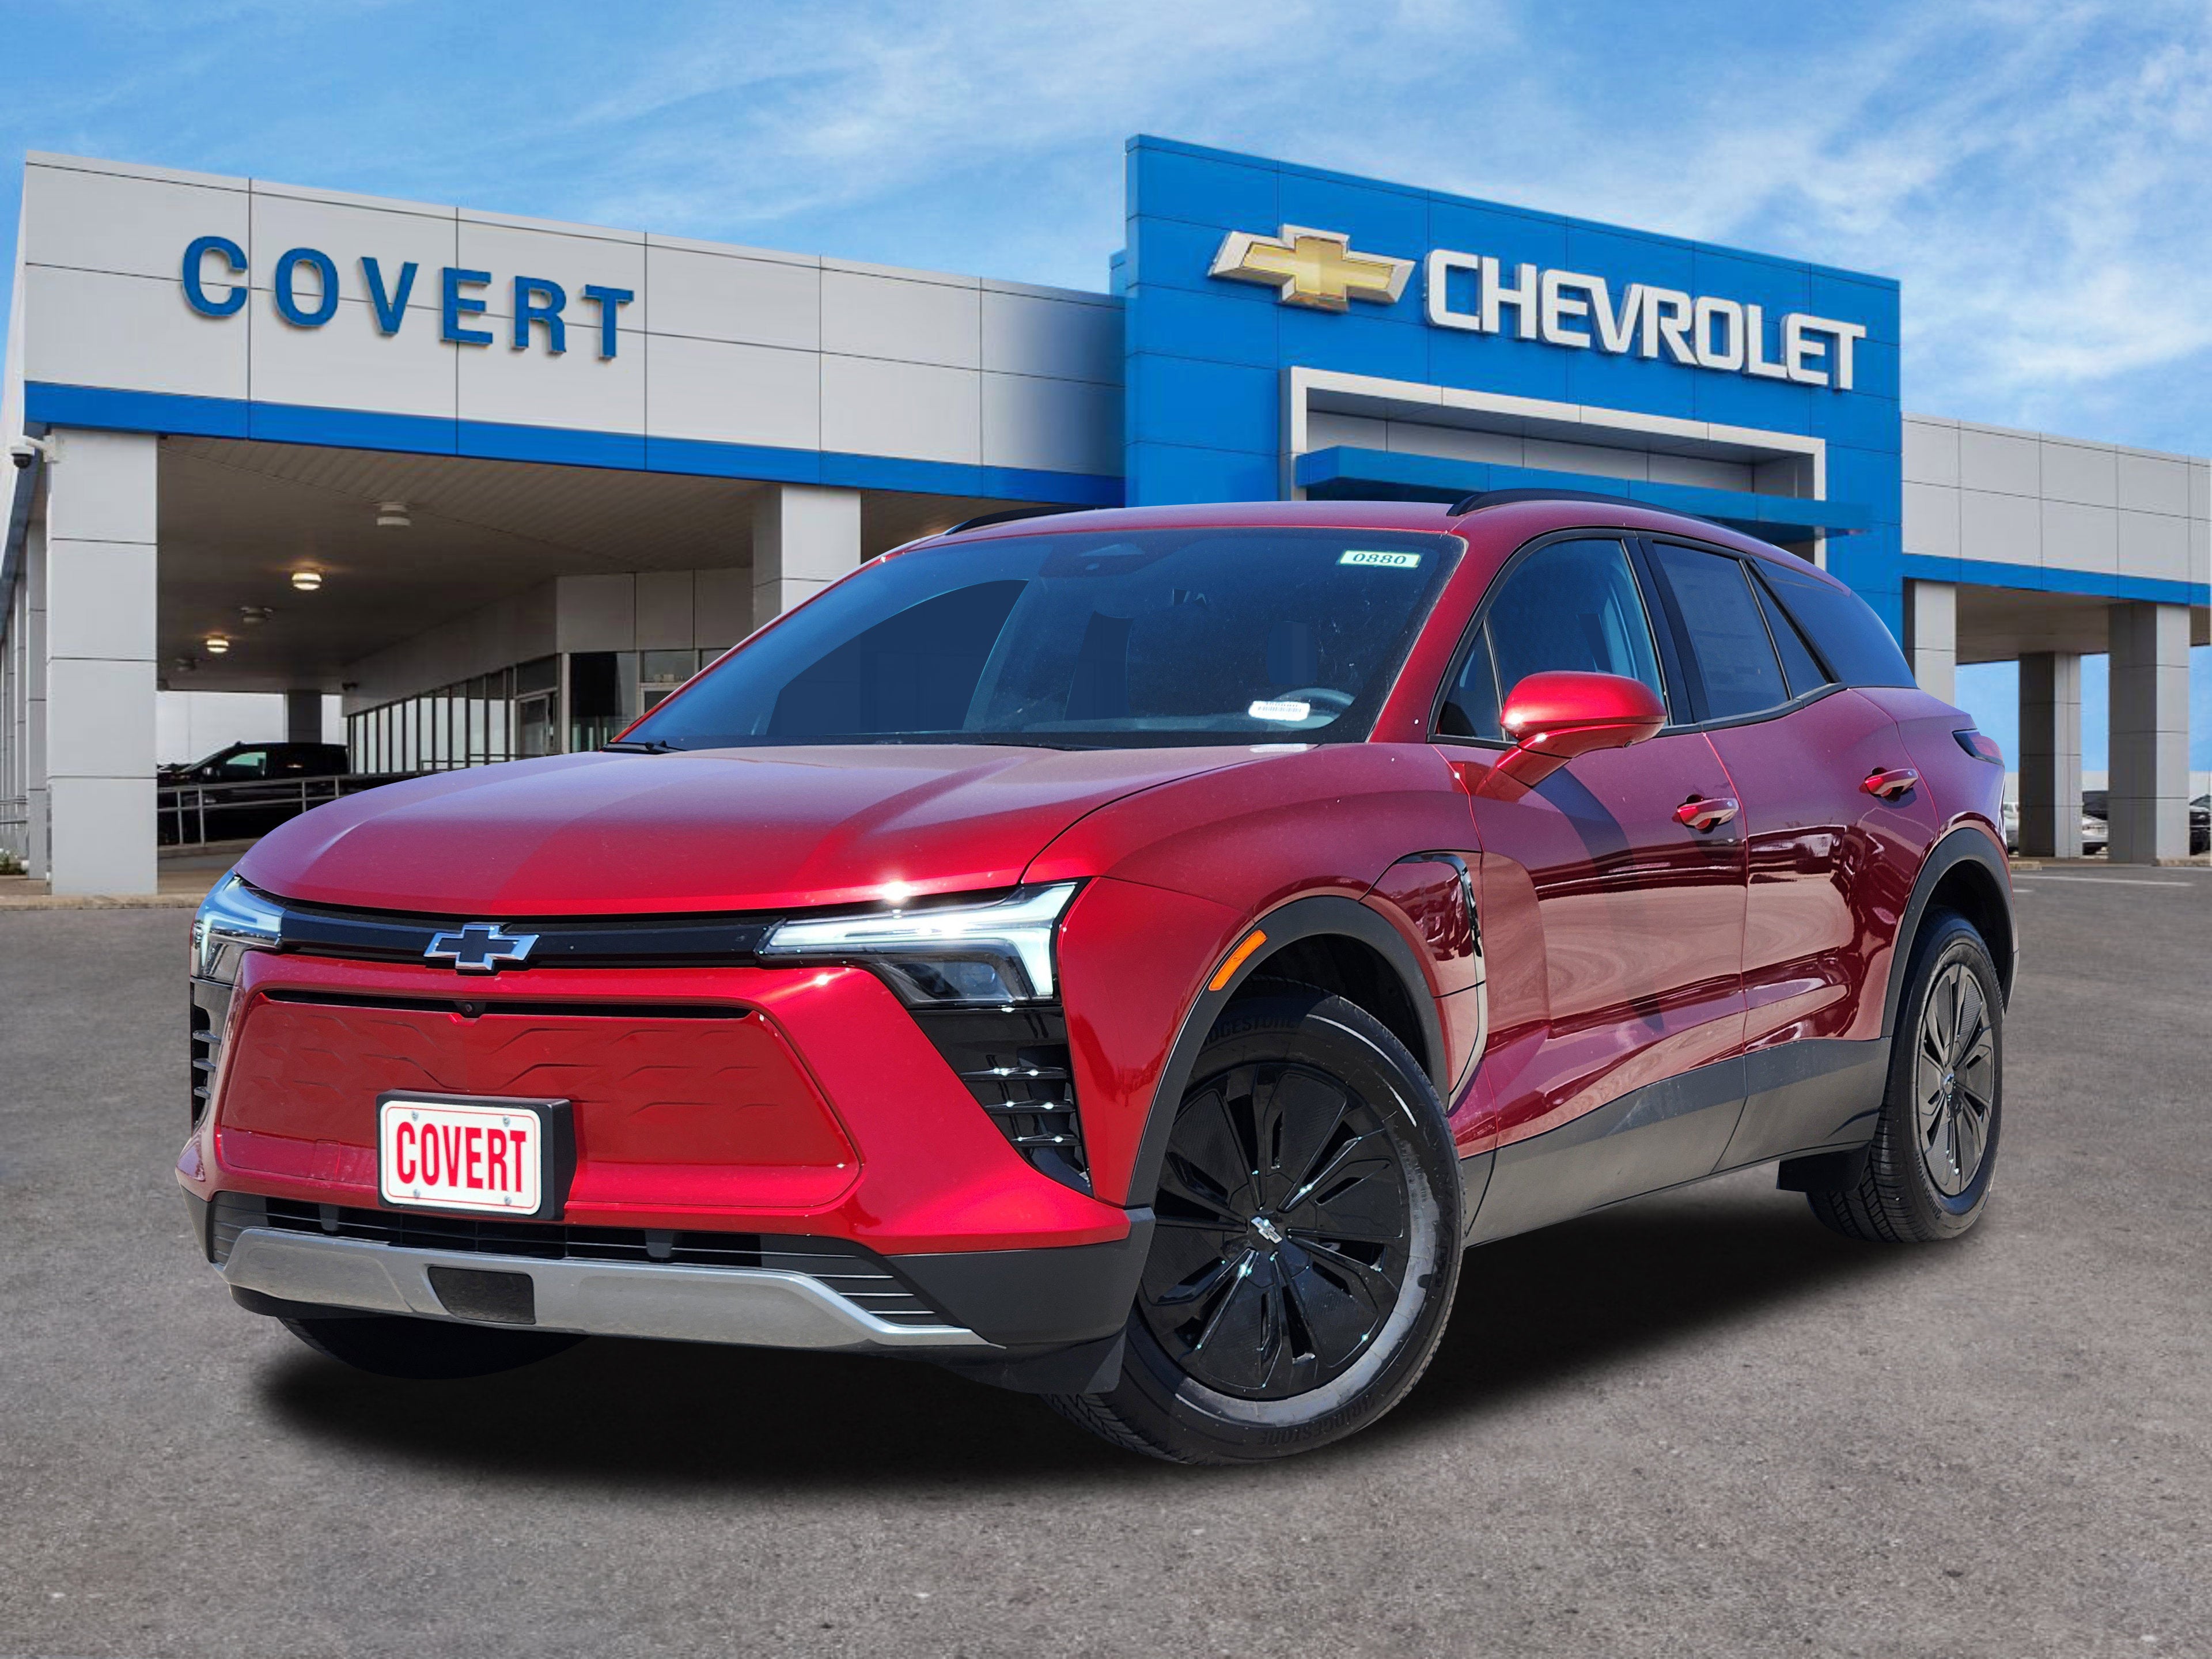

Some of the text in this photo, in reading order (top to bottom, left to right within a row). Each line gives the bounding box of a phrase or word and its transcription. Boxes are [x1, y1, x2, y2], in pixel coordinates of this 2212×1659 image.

[182, 236, 634, 361] COVERT
[1426, 249, 1866, 390] CHEVROLET
[1353, 553, 1407, 565] 0880
[396, 1122, 527, 1192] COVERT
